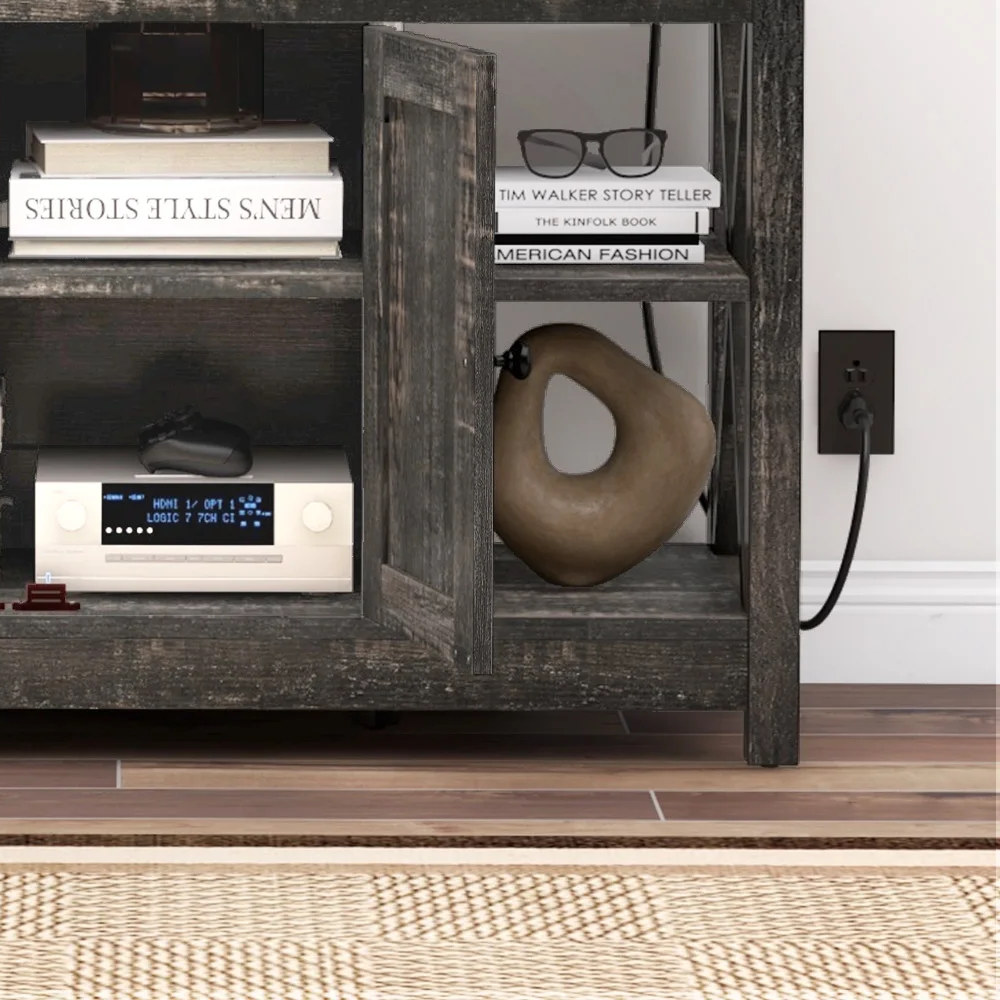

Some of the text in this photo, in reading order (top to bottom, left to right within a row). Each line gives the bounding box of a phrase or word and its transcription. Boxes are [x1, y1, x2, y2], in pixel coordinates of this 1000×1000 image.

[499, 189, 712, 201] TIM WALKER STORY TELLER
[24, 197, 322, 220] MEN'S STYLE STORIES
[535, 217, 657, 227] THE KINFOLK BOOK
[599, 248, 689, 261] FASHION
[153, 498, 178, 510] HDMI
[203, 499, 223, 510] OPT
[230, 499, 236, 510] 1
[146, 512, 180, 523] LOGIC
[185, 512, 192, 523] 7
